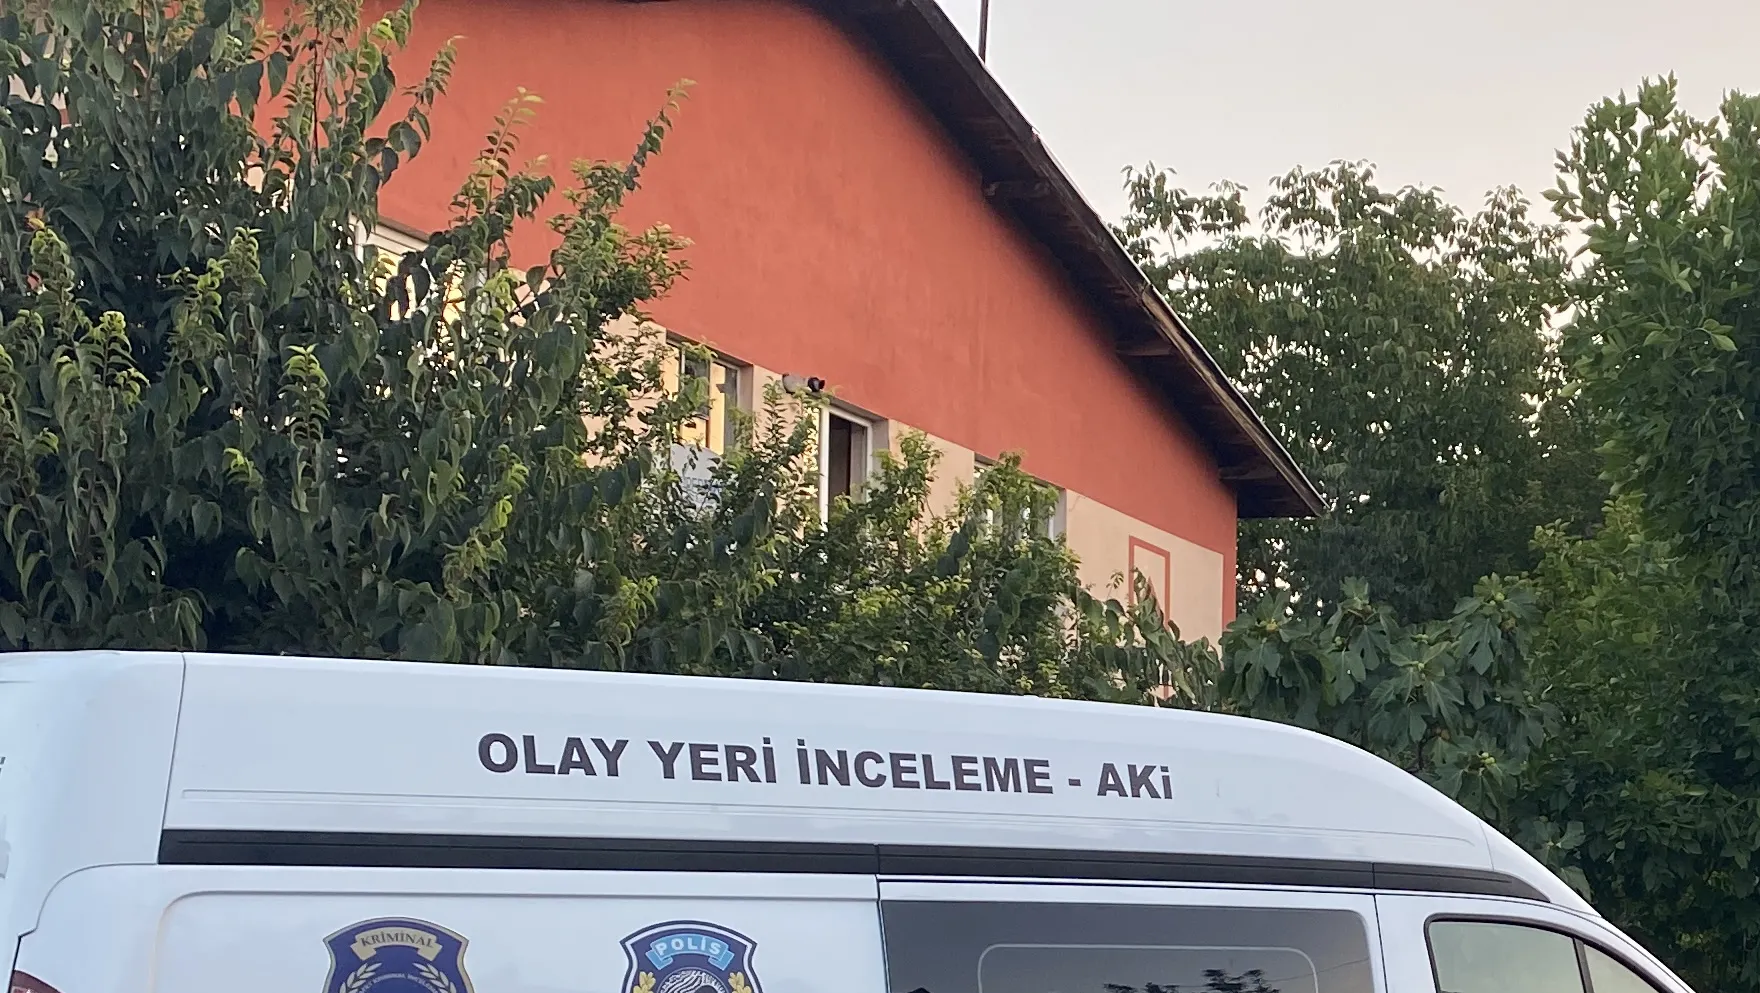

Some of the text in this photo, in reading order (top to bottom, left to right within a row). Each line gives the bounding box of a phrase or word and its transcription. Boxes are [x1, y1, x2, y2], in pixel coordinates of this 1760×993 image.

[478, 733, 629, 777] OLAY
[647, 737, 777, 784] YERİ
[796, 738, 1054, 795] İNCELEME
[361, 931, 434, 949] KRİMİNAL
[654, 937, 721, 956] POLİS
